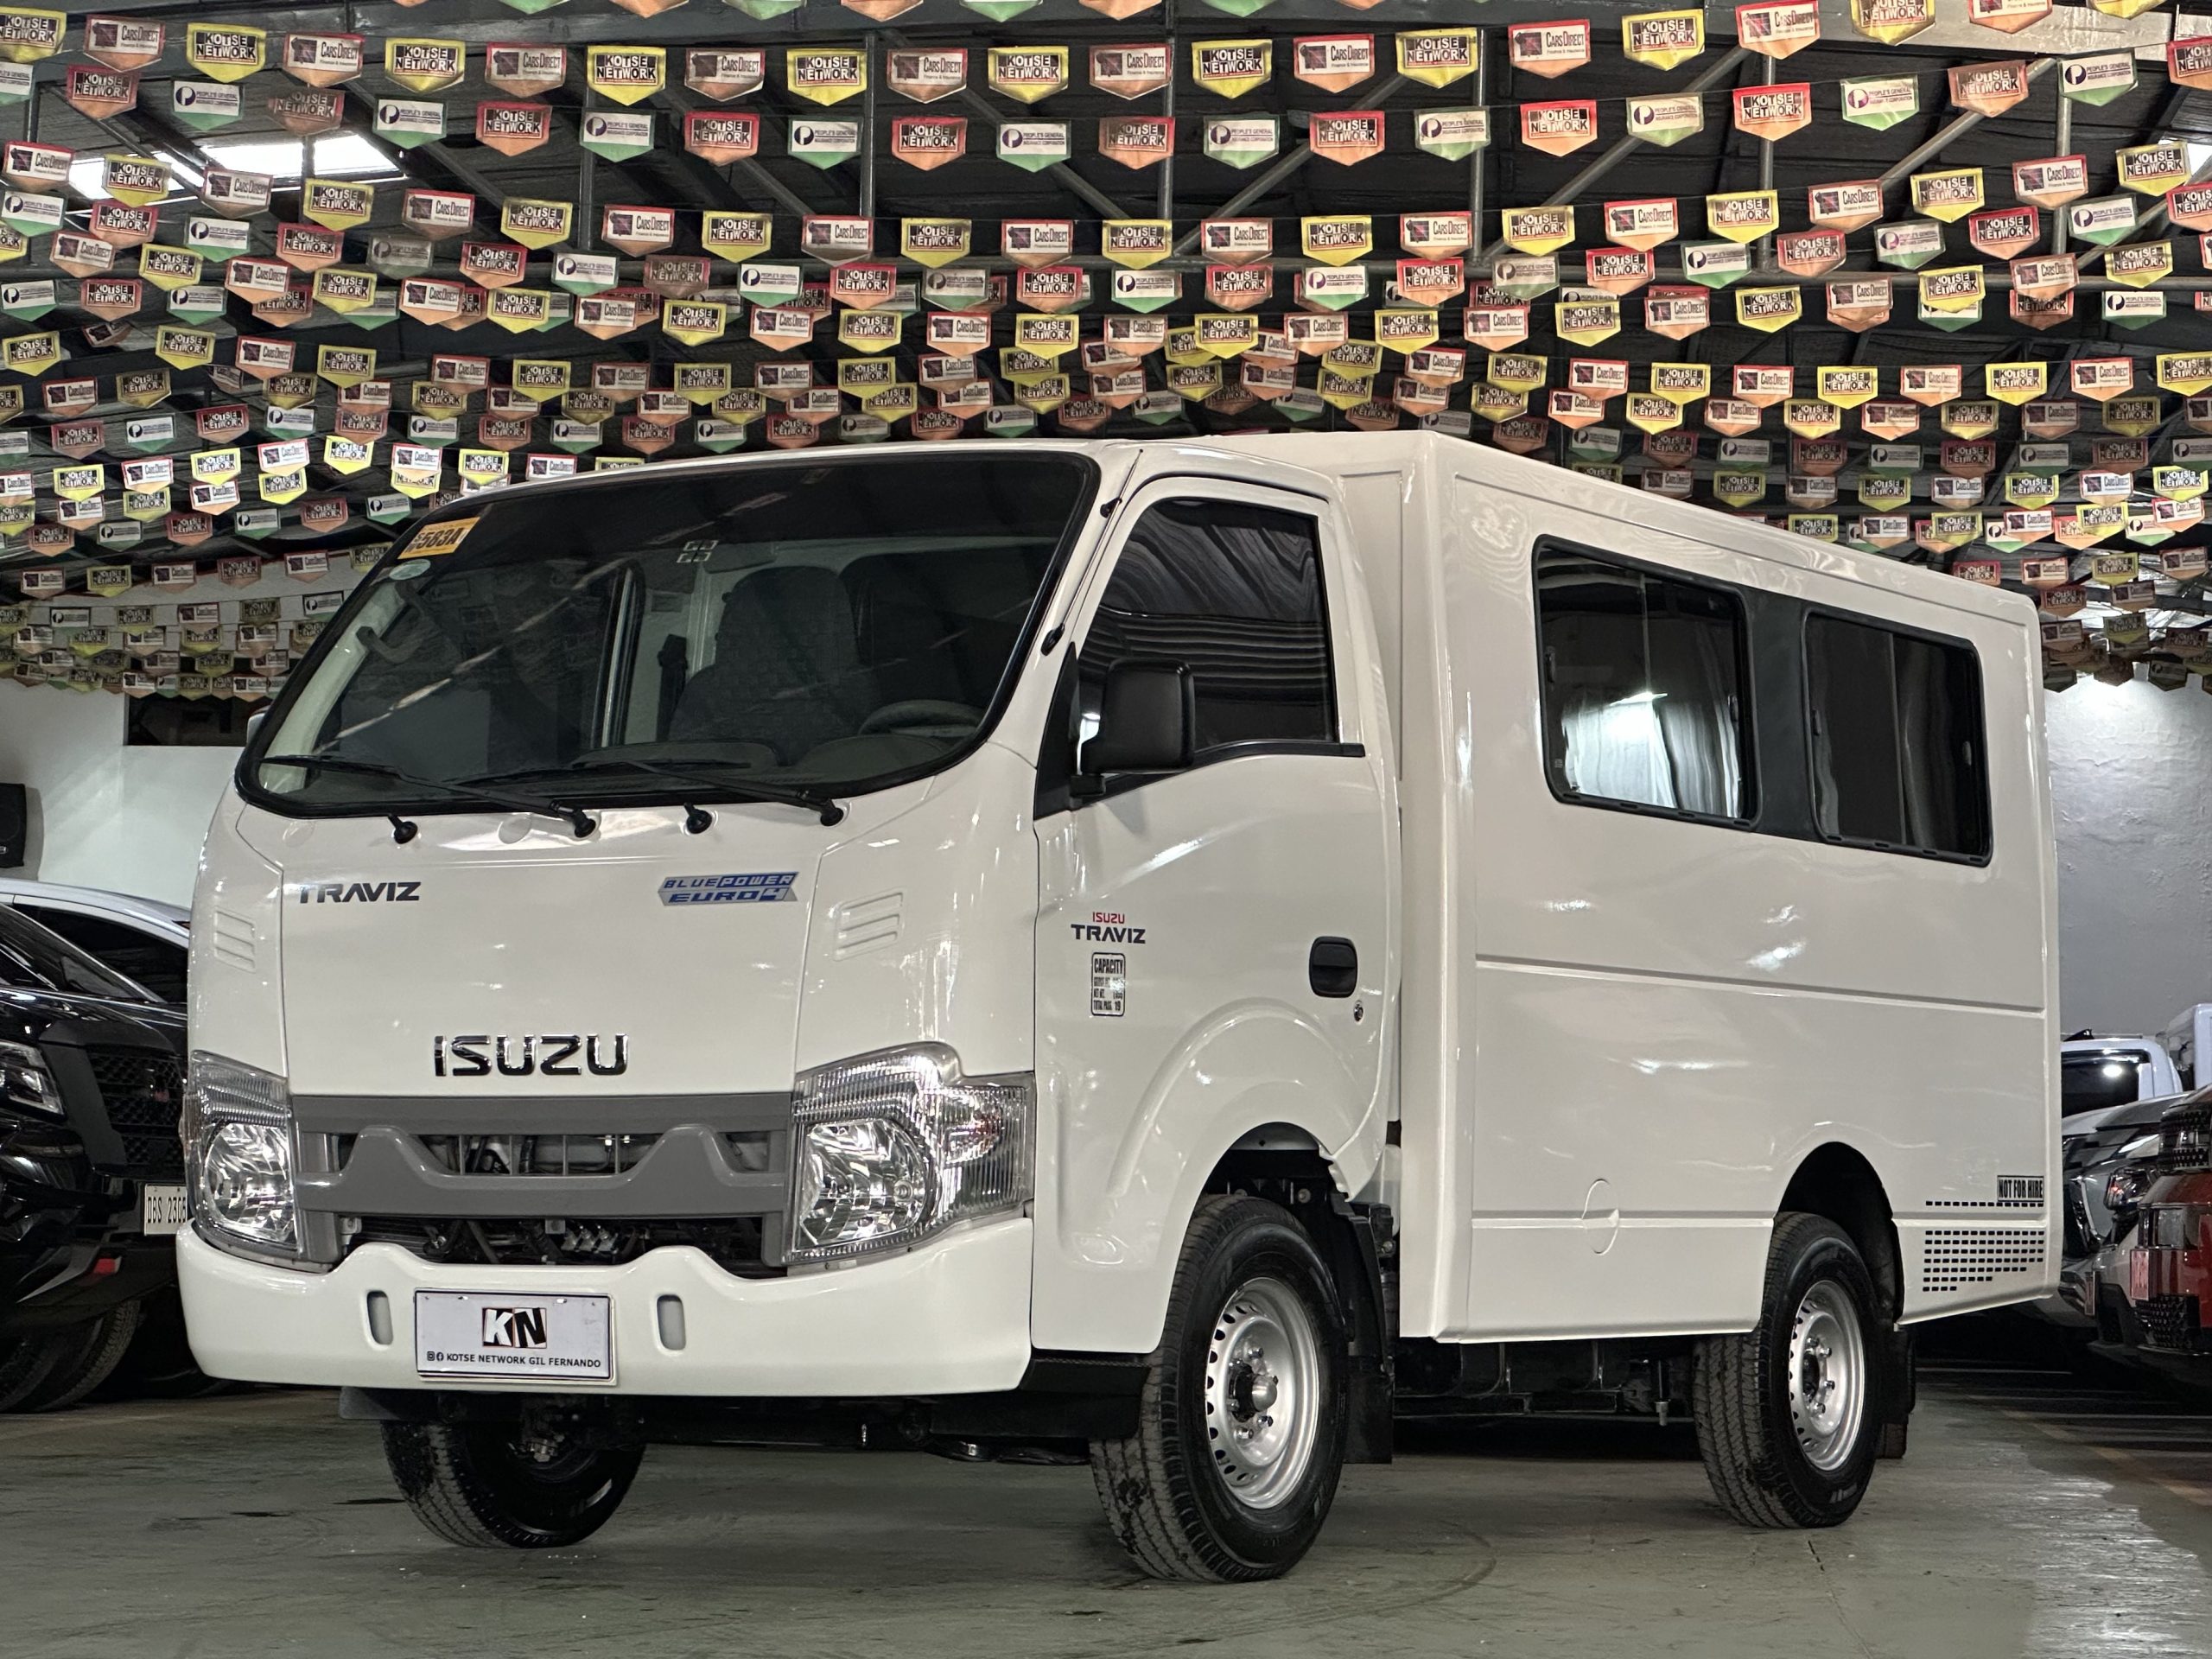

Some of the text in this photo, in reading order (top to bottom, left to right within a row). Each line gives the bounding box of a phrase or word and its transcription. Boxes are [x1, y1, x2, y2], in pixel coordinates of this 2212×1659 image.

[1863, 5, 1925, 21] NETWORK
[6, 16, 48, 29] KOTSE
[1642, 18, 1685, 33] KOTSE
[205, 34, 247, 45] KOTSE
[1415, 37, 1459, 49] KOTSE
[1633, 30, 1694, 45] NETWORK
[196, 46, 257, 59] NETWORK
[404, 47, 448, 59] KOTSE
[1211, 48, 1253, 60] KOTSE
[1407, 48, 1468, 61] NETWORK
[396, 59, 455, 71] NETWORK
[605, 54, 647, 67] KOTSE
[807, 56, 849, 67] KOTSE
[1007, 55, 1050, 67] KOTSE
[1203, 60, 1262, 73] NETWORK
[596, 67, 656, 79] NETWORK
[798, 68, 857, 79] NETWORK
[998, 67, 1058, 79] NETWORK
[1967, 69, 2010, 82] KOTSE
[84, 73, 123, 86] KOTSE
[76, 84, 129, 98] NETWORK
[1961, 79, 2018, 95] NETWORK
[1751, 93, 1793, 105] KOTSE
[494, 110, 533, 122] KOTSE
[1538, 108, 1579, 121] KOTSE
[1744, 104, 1802, 118] NETWORK
[486, 121, 541, 133] NETWORK
[702, 120, 741, 131] KOTSE
[910, 124, 950, 137] KOTSE
[1328, 119, 1367, 131] KOTSE
[1531, 119, 1588, 133] NETWORK
[694, 131, 750, 143] NETWORK
[902, 136, 957, 147] NETWORK
[1109, 134, 1166, 146] NETWORK
[1319, 130, 1376, 143] NETWORK
[2134, 150, 2173, 163] KOTSE
[118, 162, 156, 175] KOTSE
[2126, 160, 2183, 175] NETWORK
[110, 174, 161, 188] NETWORK
[1928, 176, 1967, 190] KOTSE
[321, 187, 358, 199] KOTSE
[1921, 187, 1975, 201] NETWORK
[313, 197, 365, 211] NETWORK
[1725, 198, 1762, 211] KOTSE
[108, 207, 143, 220] KOTSE
[519, 204, 556, 217] KOTSE
[1716, 208, 1770, 222] NETWORK
[99, 216, 148, 230] NETWORK
[511, 214, 562, 229] NETWORK
[719, 219, 756, 230] KOTSE
[1520, 213, 1558, 226] KOTSE
[1987, 217, 2023, 230] KOTSE
[711, 229, 763, 240] NETWORK
[918, 226, 955, 236] KOTSE
[1120, 226, 1156, 237] KOTSE
[1319, 223, 1355, 234] KOTSE
[1512, 223, 1566, 236] NETWORK
[1980, 226, 2031, 240] NETWORK
[910, 235, 961, 246] NETWORK
[1110, 237, 1163, 247] NETWORK
[1311, 232, 1363, 245] NETWORK
[478, 247, 512, 259] KOTSE
[1787, 246, 1838, 259] NETWORK
[470, 257, 518, 270] NETWORK
[1602, 255, 1638, 265] KOTSE
[845, 270, 880, 280] KOTSE
[1223, 270, 1258, 282] KOTSE
[1413, 265, 1449, 276] KOTSE
[1596, 264, 1646, 276] NETWORK
[1033, 272, 1067, 283] KOTSE
[1406, 275, 1456, 287] NETWORK
[95, 285, 128, 295] KOTSE
[838, 280, 887, 291] NETWORK
[1025, 282, 1074, 293] NETWORK
[1216, 279, 1265, 291] NETWORK
[88, 294, 133, 303] NETWORK
[1751, 294, 1786, 305] KOTSE
[678, 308, 711, 318] KOTSE
[1745, 302, 1794, 315] NETWORK
[671, 317, 717, 327] NETWORK
[1210, 320, 1243, 329] KOTSE
[847, 324, 894, 334] NETWORK
[1203, 328, 1249, 339] NETWORK
[664, 874, 794, 888] BLUEPOWER
[300, 882, 422, 904] TRAVIZ
[1092, 912, 1125, 924] ISUZU
[1071, 924, 1146, 944] TRAVIZ
[1094, 958, 1123, 974] CAPACITY
[434, 1033, 628, 1077] ISUZU
[1999, 1179, 2043, 1198] NOT FOR HIRE
[447, 1353, 601, 1368] KOTSE NETWORK GIL FERNANDO
